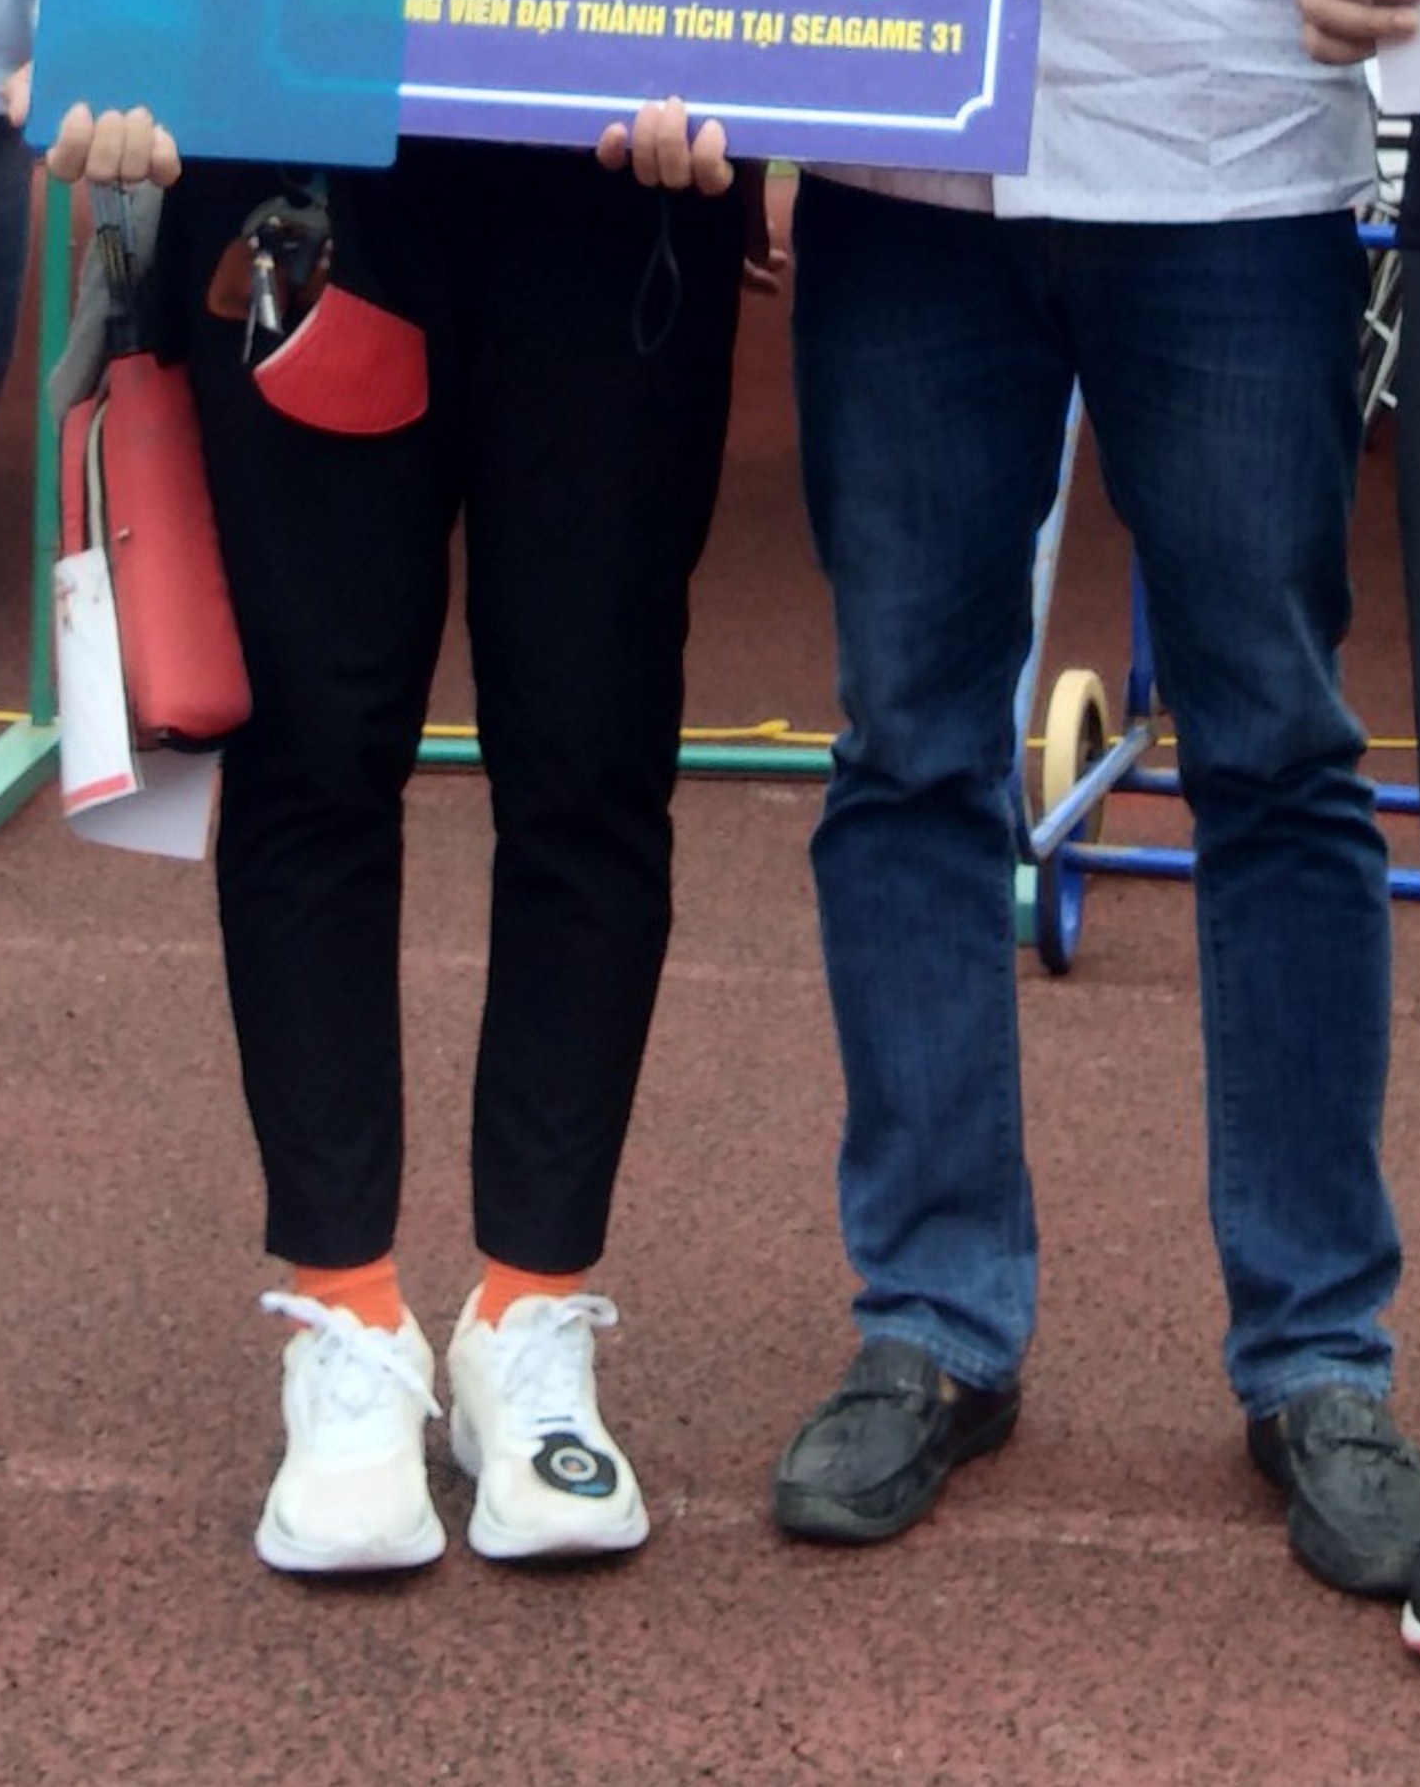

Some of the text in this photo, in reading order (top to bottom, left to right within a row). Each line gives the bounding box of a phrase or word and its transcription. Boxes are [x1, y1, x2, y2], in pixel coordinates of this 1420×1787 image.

[673, 2, 734, 41] TÍCH
[741, 9, 784, 49] TẠI
[790, 14, 924, 52] SEAGAME
[930, 22, 963, 54] 31
